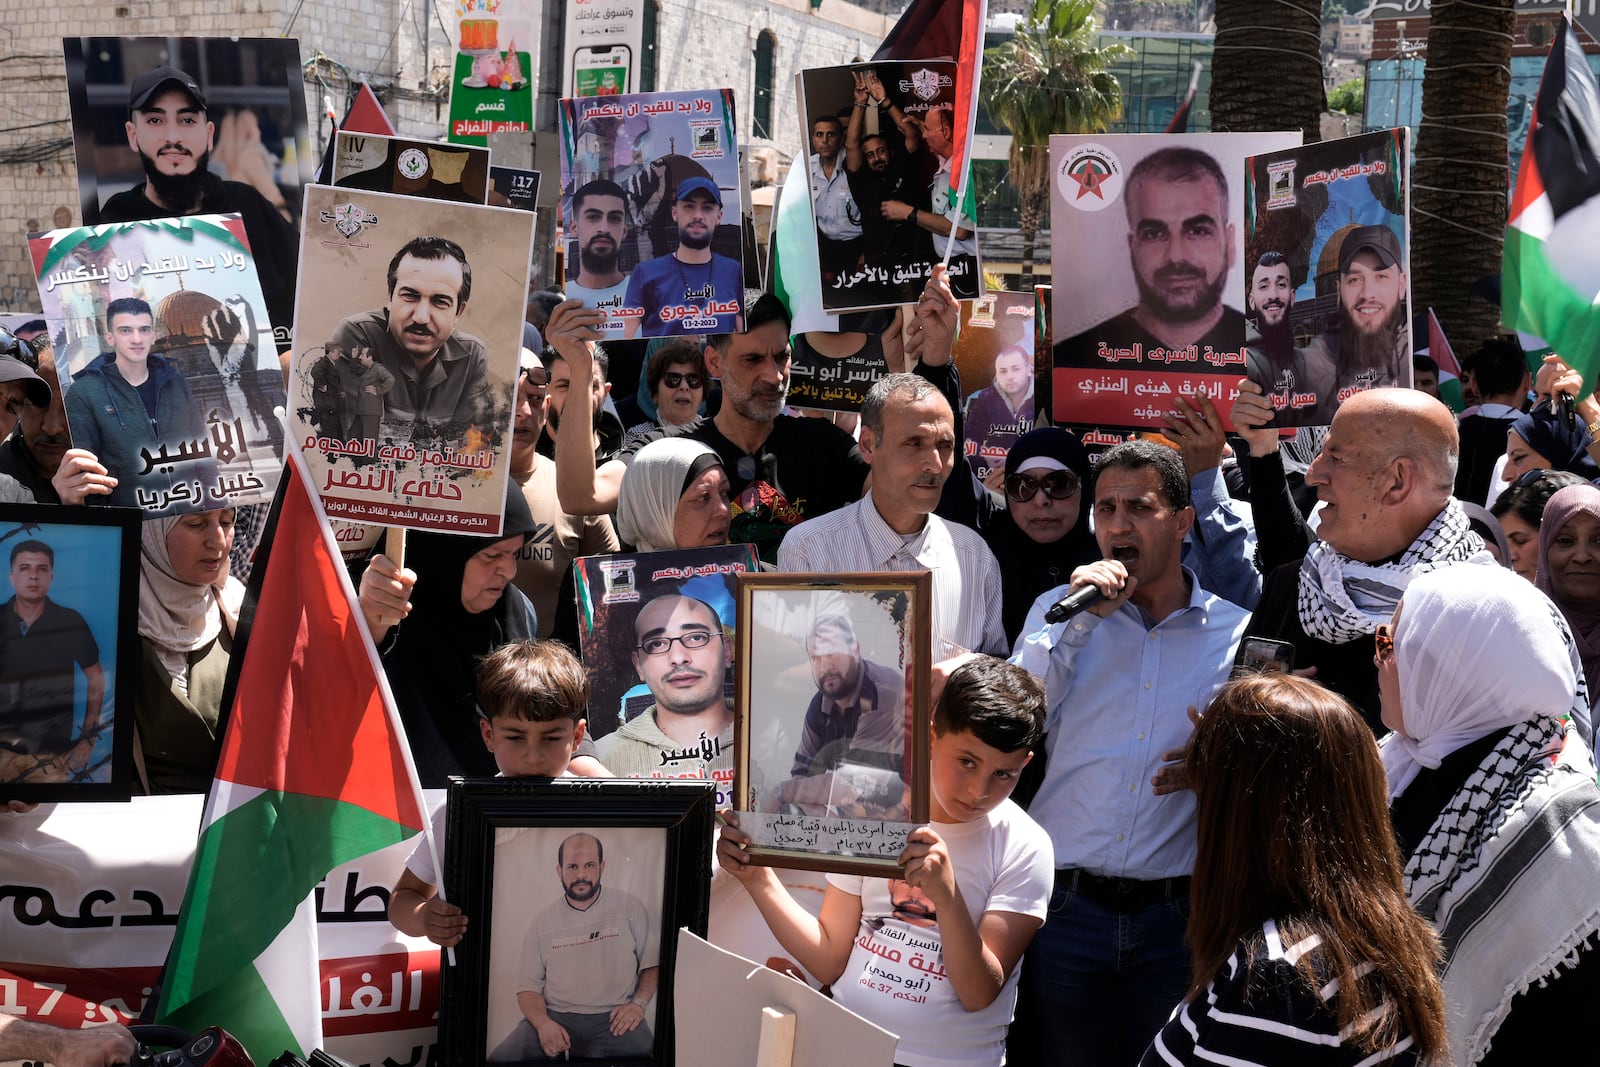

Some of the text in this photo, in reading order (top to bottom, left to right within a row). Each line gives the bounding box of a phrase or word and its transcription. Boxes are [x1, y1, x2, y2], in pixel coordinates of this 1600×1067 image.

[475, 98, 506, 114] قسم
[583, 99, 713, 120] ولا بد للقيد ان ينكسر
[456, 119, 493, 136] الأفراح
[1340, 164, 1361, 180] للقيد
[1362, 165, 1372, 175] بد
[1373, 161, 1387, 175] ولا
[517, 175, 534, 189] 17
[1303, 171, 1329, 189] ينكسر
[195, 256, 216, 271] بد
[218, 251, 247, 272] ولا
[46, 265, 110, 292] ينكسر
[114, 262, 135, 282] ان
[831, 261, 969, 289] الحة تليق بالأحرار
[683, 282, 715, 300] الأسير
[596, 294, 622, 309] الأسير
[703, 299, 741, 317] كمال
[611, 307, 645, 318] محمد
[683, 318, 717, 329] 13-2-2023
[1097, 341, 1249, 368] الحرية لأسرى الحرية
[789, 360, 816, 380] بك
[818, 360, 843, 383] أبو
[788, 381, 819, 400] بالأحر
[820, 386, 844, 401] تليق
[1134, 378, 1172, 397] هيثم
[1178, 380, 1223, 401] الرفيق
[1291, 391, 1317, 409] معين
[1133, 404, 1162, 420] مؤبد
[988, 415, 1034, 438] الأسير
[137, 407, 248, 476] الأسير
[300, 434, 495, 471] لنستمر في الهجوم
[979, 446, 1009, 459] حمد
[136, 472, 265, 510] خليل زكريا
[322, 466, 463, 502] حتى النصر
[326, 501, 348, 512] الوزير
[347, 504, 366, 514] خليل
[367, 506, 389, 517] القائد
[389, 509, 418, 521] الشهيد
[445, 514, 459, 525] 36
[459, 515, 488, 527] الذكرى
[652, 568, 682, 582] ينكسر
[694, 563, 719, 577] للقيد
[720, 564, 731, 574] بد
[732, 561, 746, 574] ولا
[658, 731, 721, 766] الأسير
[836, 840, 854, 852] عام
[856, 935, 948, 981] يبة مسلم
[859, 976, 927, 1004] الحكم 37 عام
